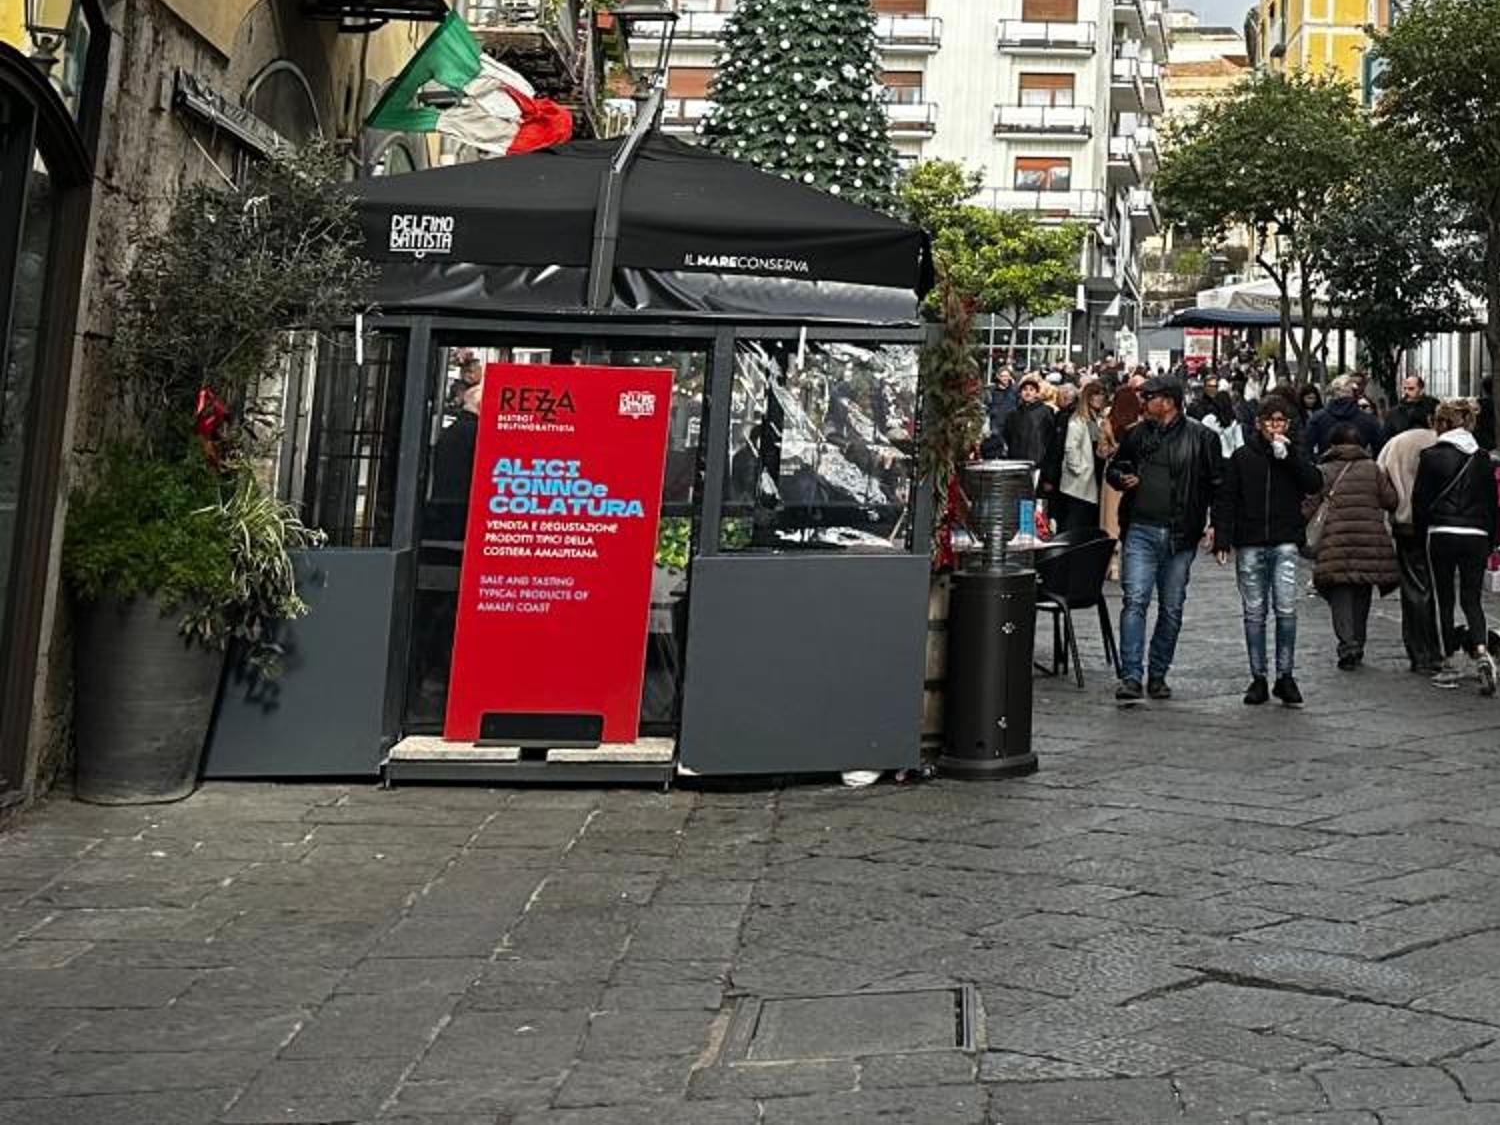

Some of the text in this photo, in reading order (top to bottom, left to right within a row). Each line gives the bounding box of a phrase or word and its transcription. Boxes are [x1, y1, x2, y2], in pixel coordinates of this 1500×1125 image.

[391, 214, 455, 232] DELFINO
[389, 229, 453, 248] BATTISTA
[492, 458, 580, 478] ALICI
[488, 496, 645, 518] COLATURA
[486, 520, 619, 533] VENDITA E DEGUSTAZIONE
[484, 533, 594, 546] PRODOTTI TIPICI DELLA
[483, 546, 598, 559] COSTIERA AMALFITANA
[480, 575, 575, 587] SALE AND TASTING
[479, 588, 589, 600] TYPICAL PRODUCTS OF
[477, 602, 551, 613] AMALFI COAST
